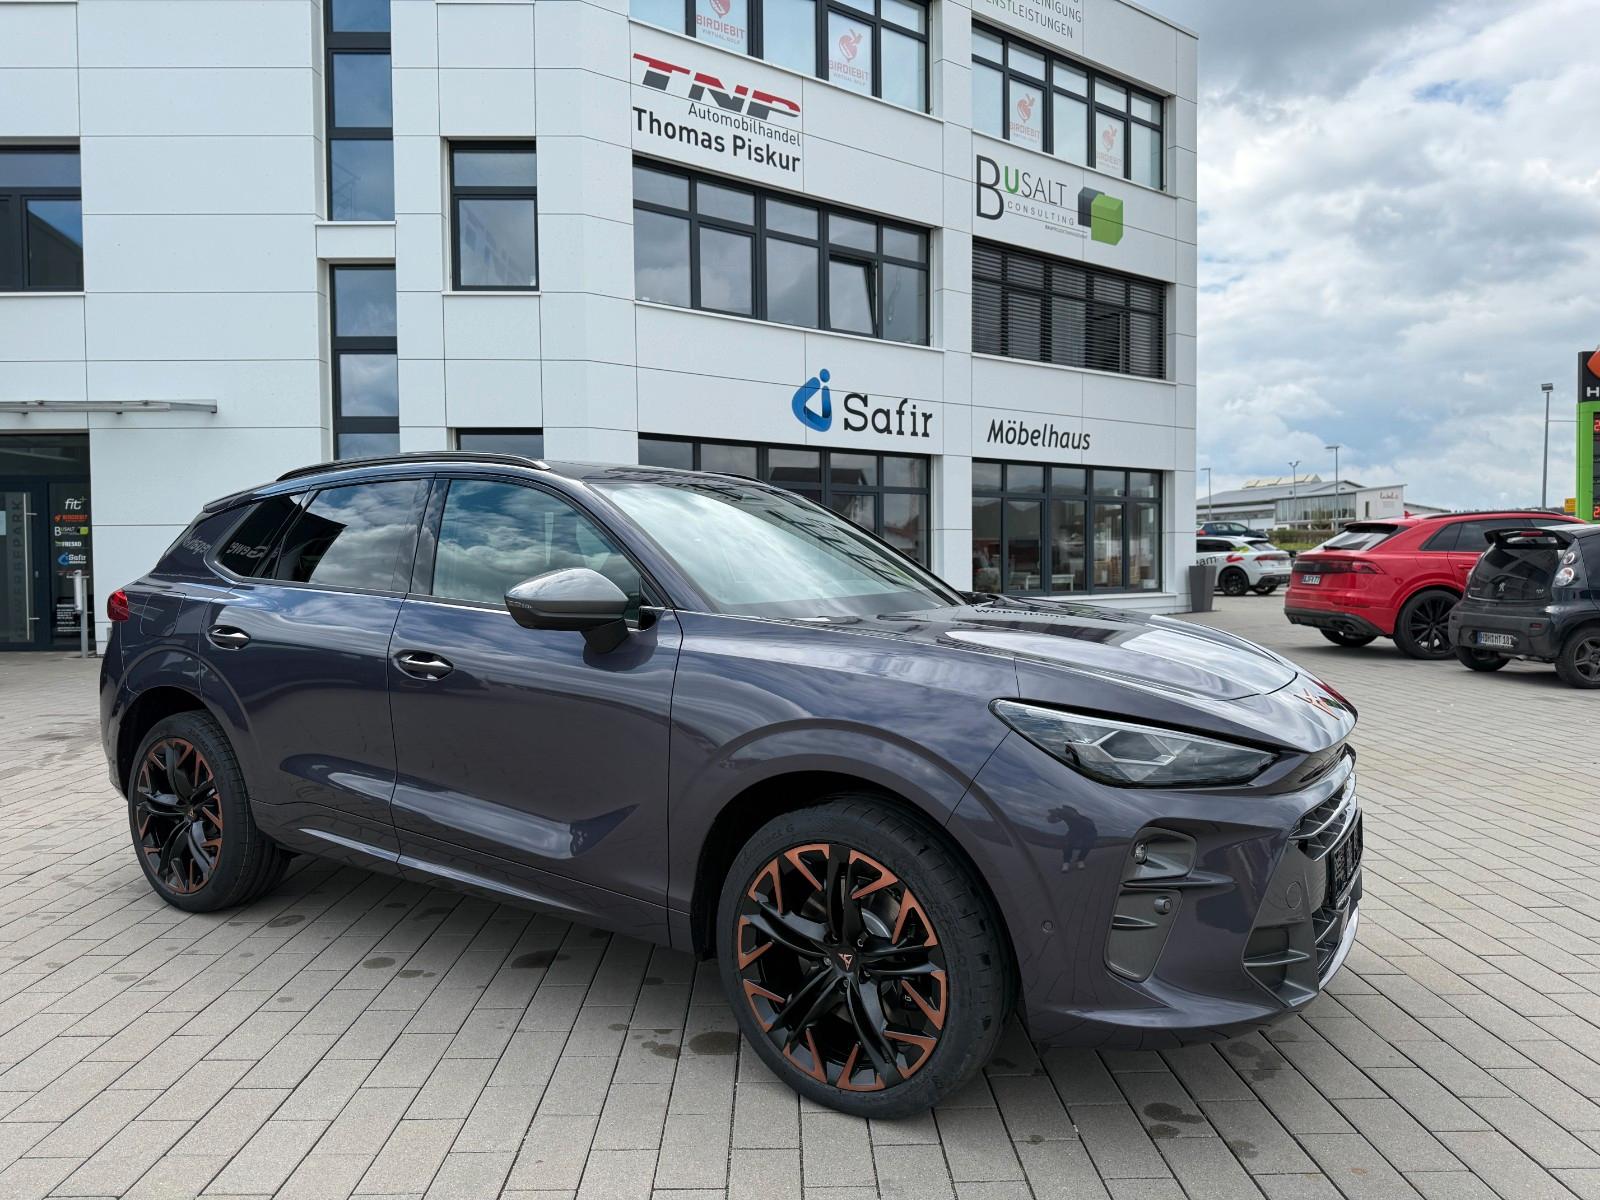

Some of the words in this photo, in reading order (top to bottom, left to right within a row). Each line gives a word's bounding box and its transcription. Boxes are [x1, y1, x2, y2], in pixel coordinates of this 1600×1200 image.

[696, 14, 746, 39] BIRDIEBIT
[1032, 0, 1082, 23] INIGUNG
[633, 53, 801, 120] TNP
[829, 59, 868, 81] BIRDIEBIT
[632, 106, 725, 153] Thomas
[733, 134, 801, 173] Piskur
[688, 102, 801, 147] Automobilhandel
[976, 154, 1068, 221] BUSALT
[1007, 200, 1075, 226] CONSULTING
[843, 392, 933, 438] Safir
[987, 418, 1091, 451] Möbelhaus
